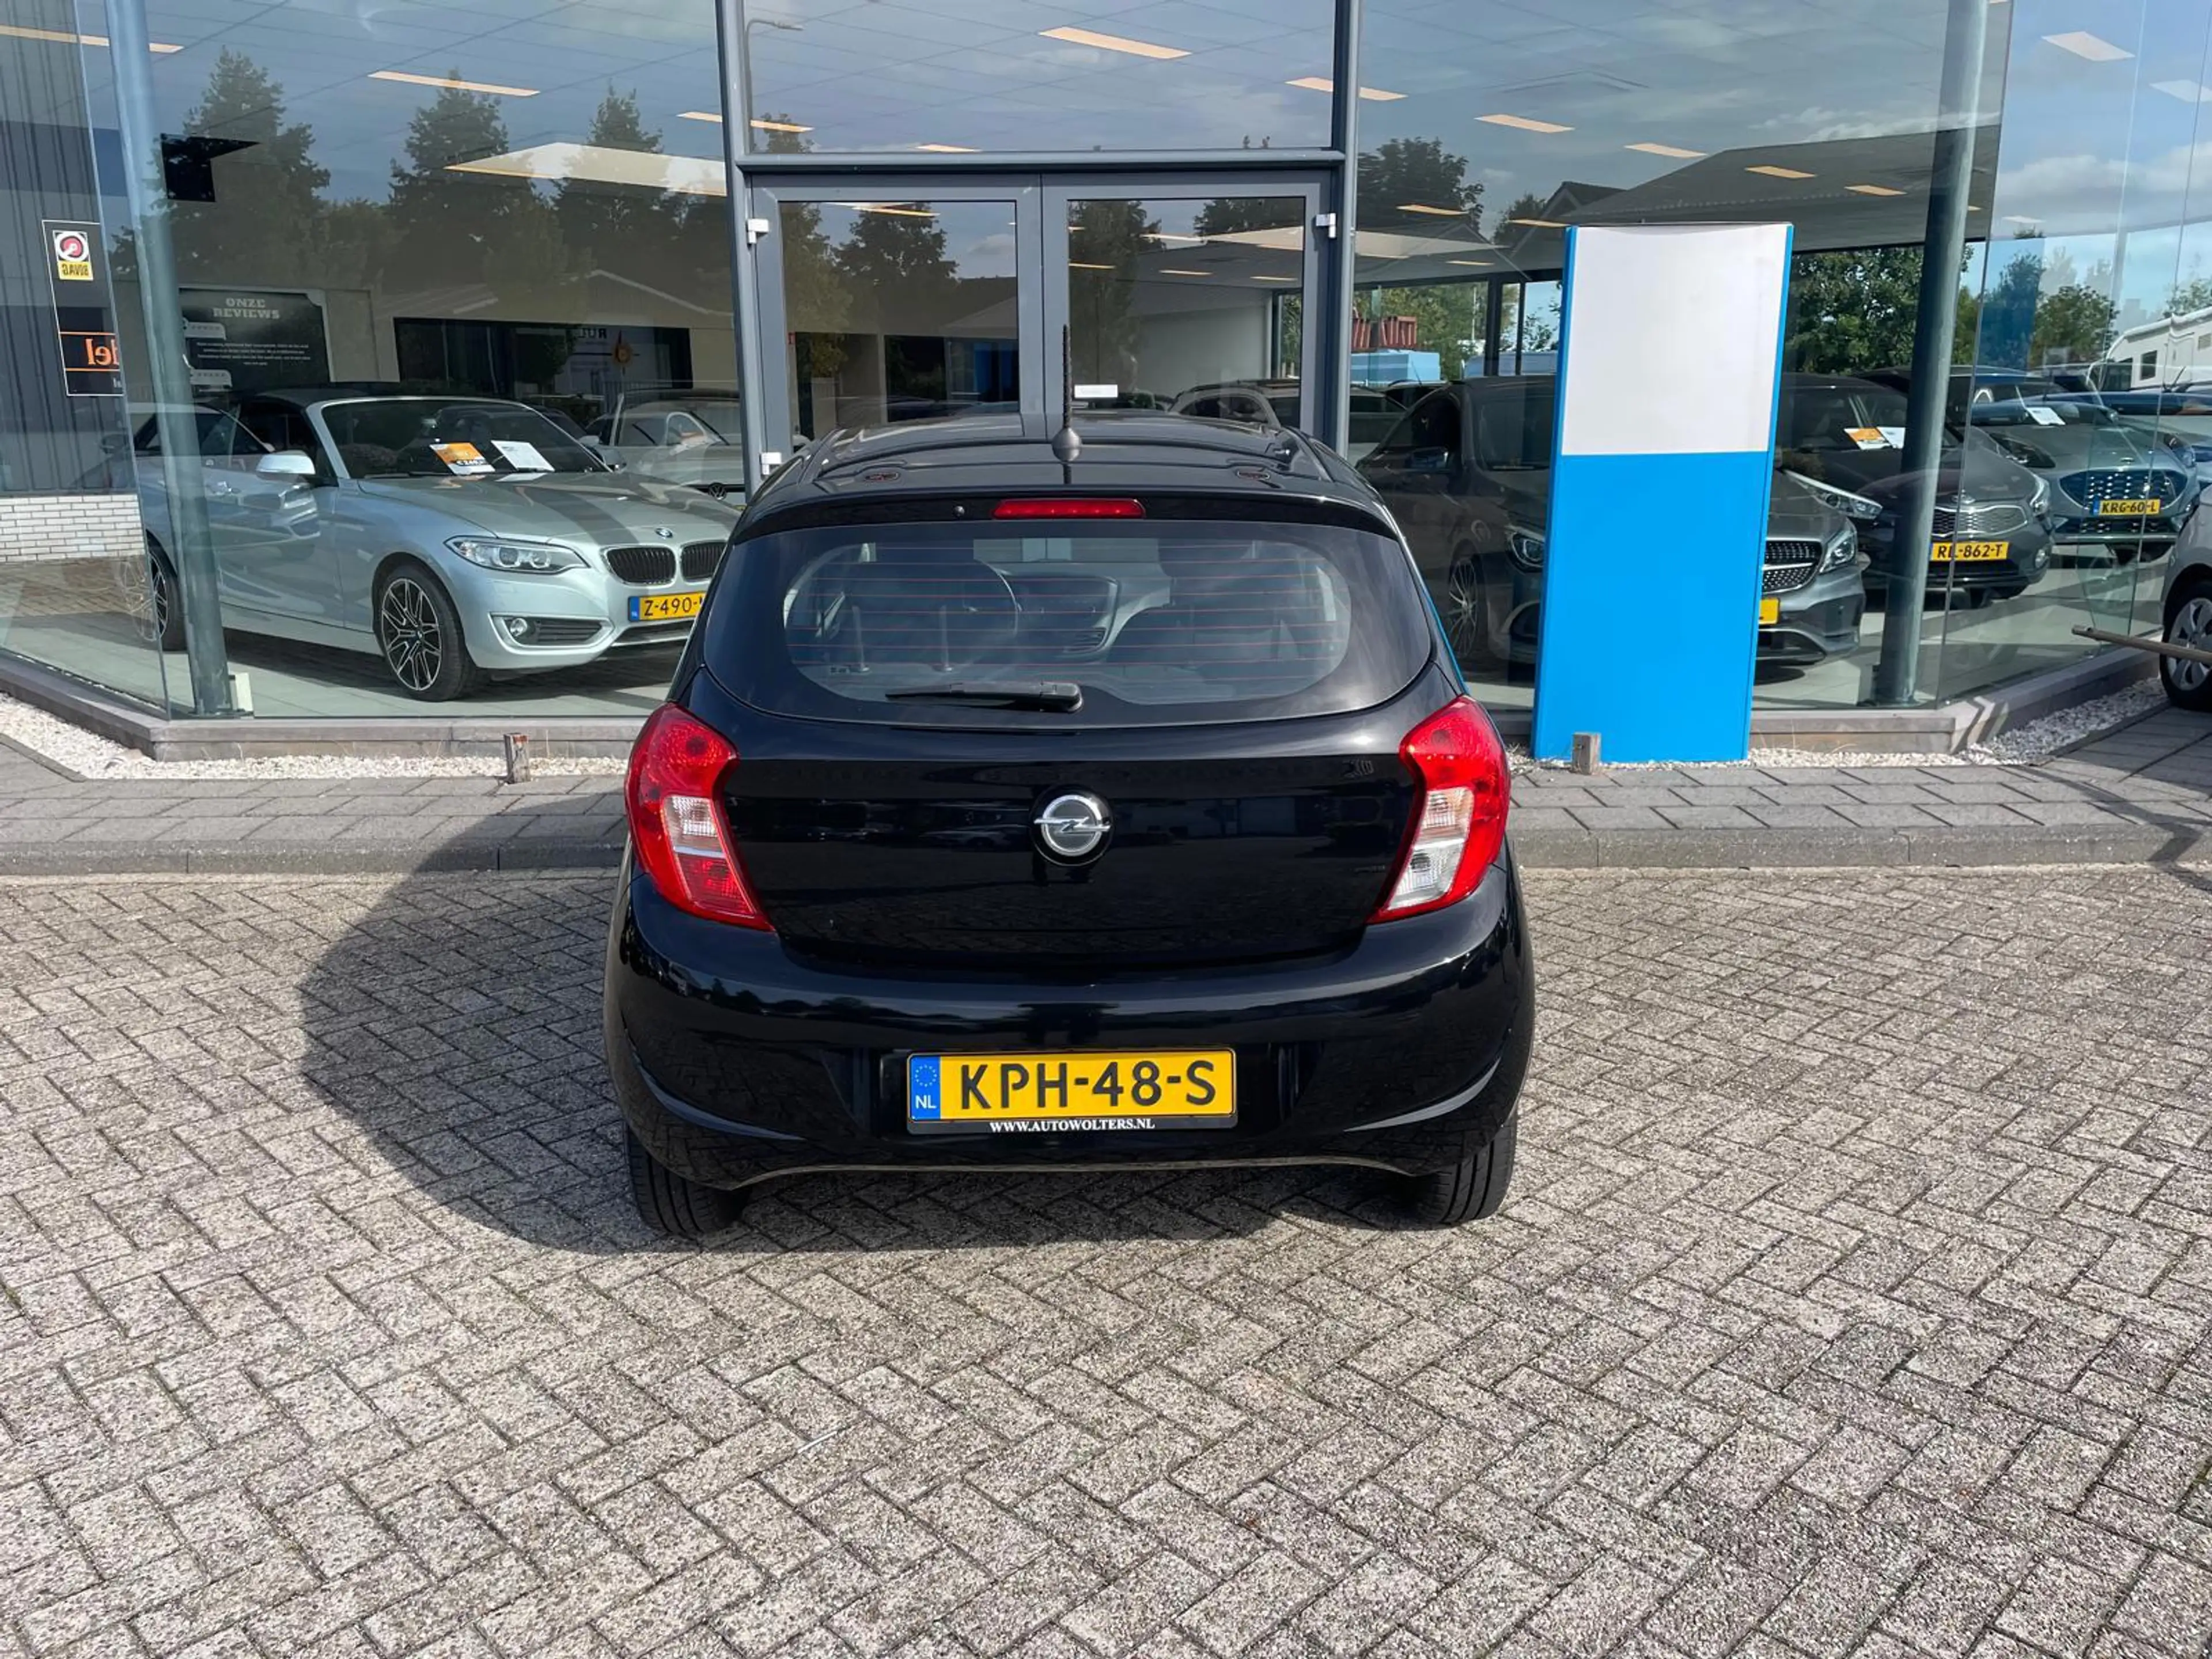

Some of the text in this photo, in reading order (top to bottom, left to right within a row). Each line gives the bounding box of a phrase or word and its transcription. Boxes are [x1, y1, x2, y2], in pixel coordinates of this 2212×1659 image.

[225, 297, 266, 308] ONZE
[213, 308, 280, 319] REVIEWS
[2101, 501, 2158, 513] KRG-60-L
[960, 1060, 1217, 1109] KPH-48-S
[915, 1096, 937, 1109] NL
[989, 1118, 1156, 1133] WWW.AUTOWOLTERS.NL
